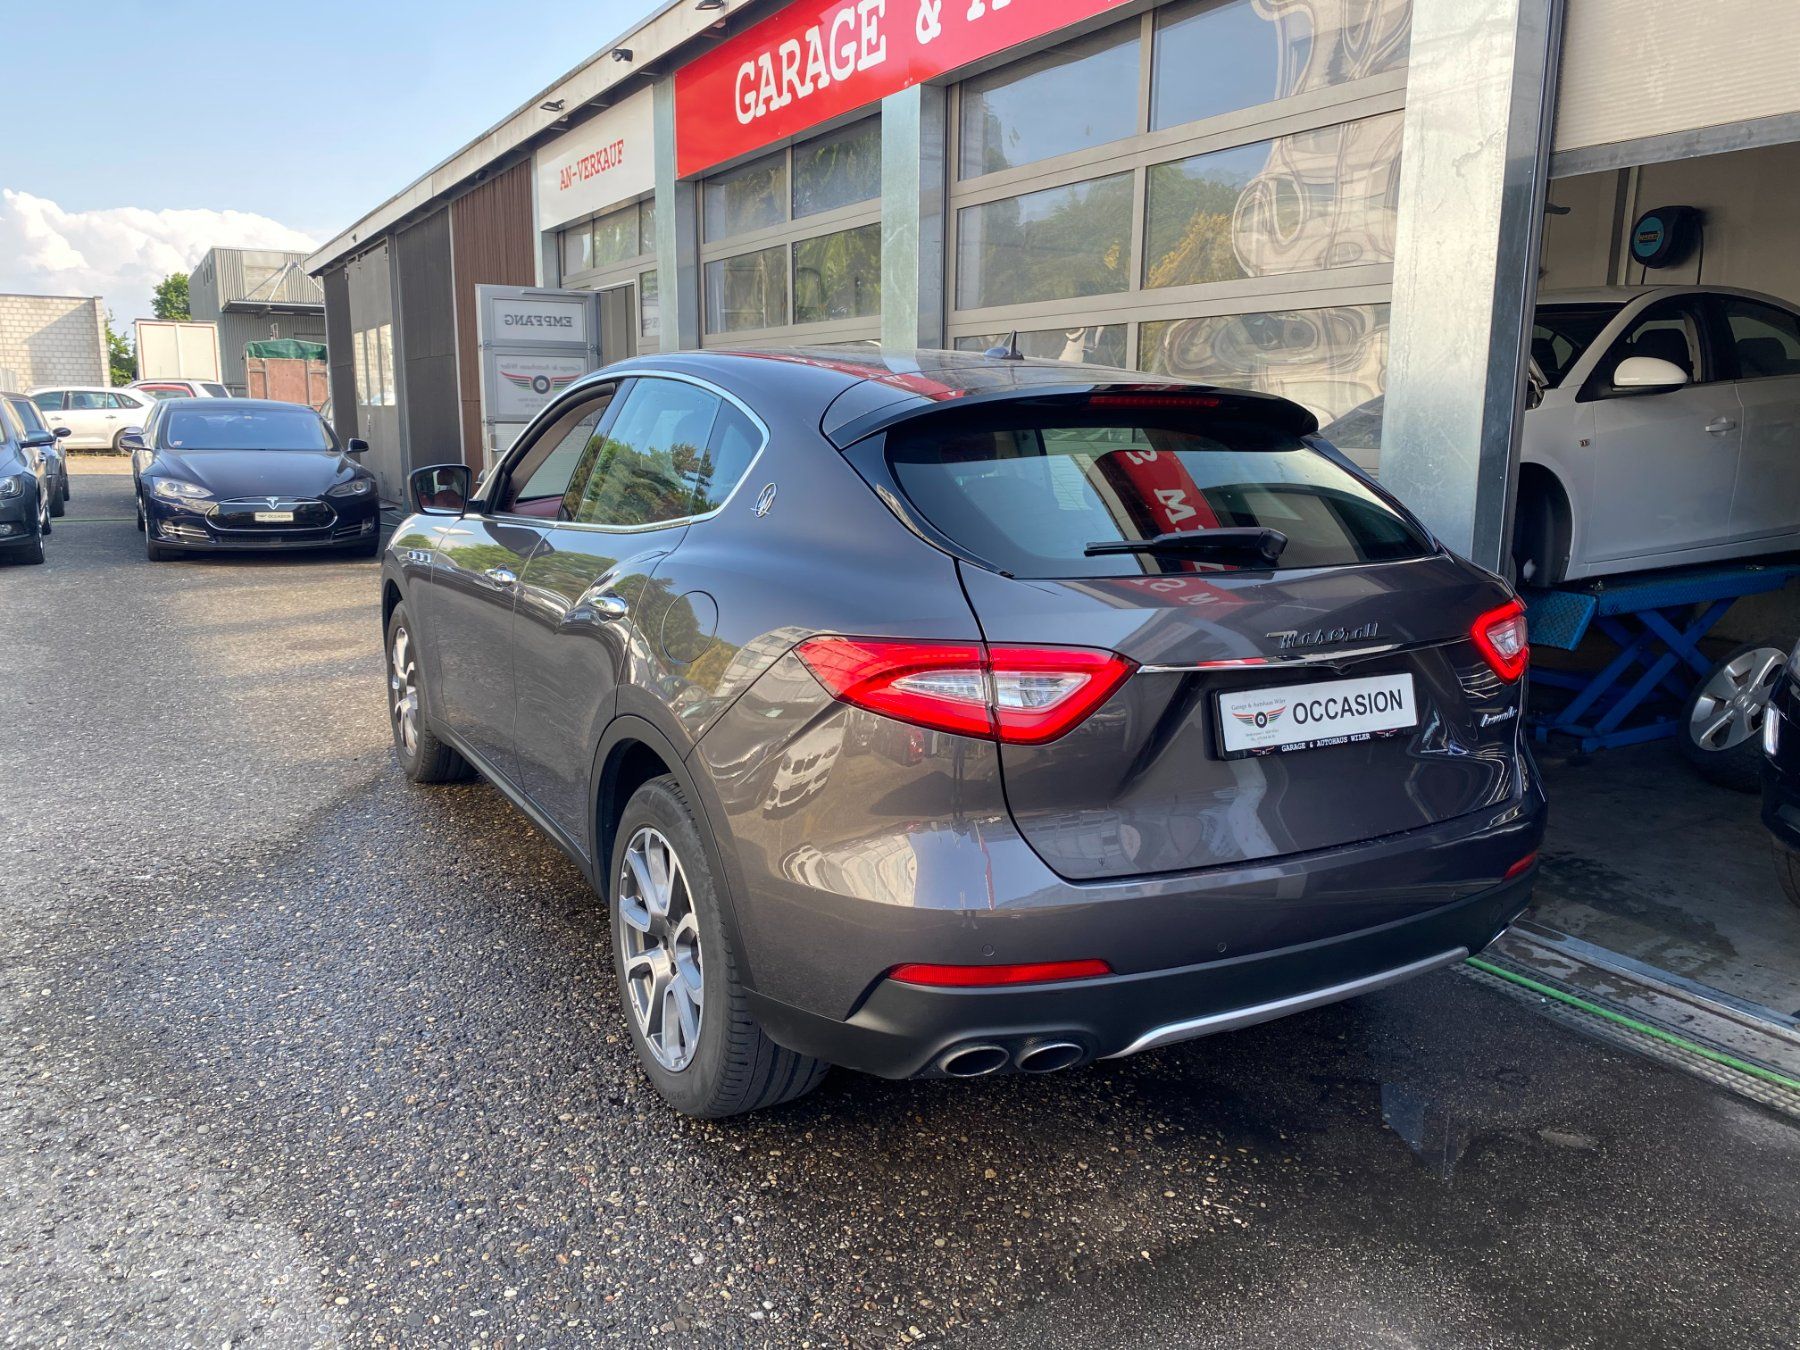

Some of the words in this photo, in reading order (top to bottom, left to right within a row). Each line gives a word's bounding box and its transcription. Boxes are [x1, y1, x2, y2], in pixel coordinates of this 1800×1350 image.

[734, 0, 886, 125] GARAGE
[915, 0, 942, 45] &
[560, 139, 624, 191] AN-VERKAUF
[1292, 689, 1403, 725] OCCASION
[1281, 742, 1306, 752] GARAGE
[1317, 736, 1348, 747] AUTOHAUS
[1351, 733, 1371, 742] WILER
